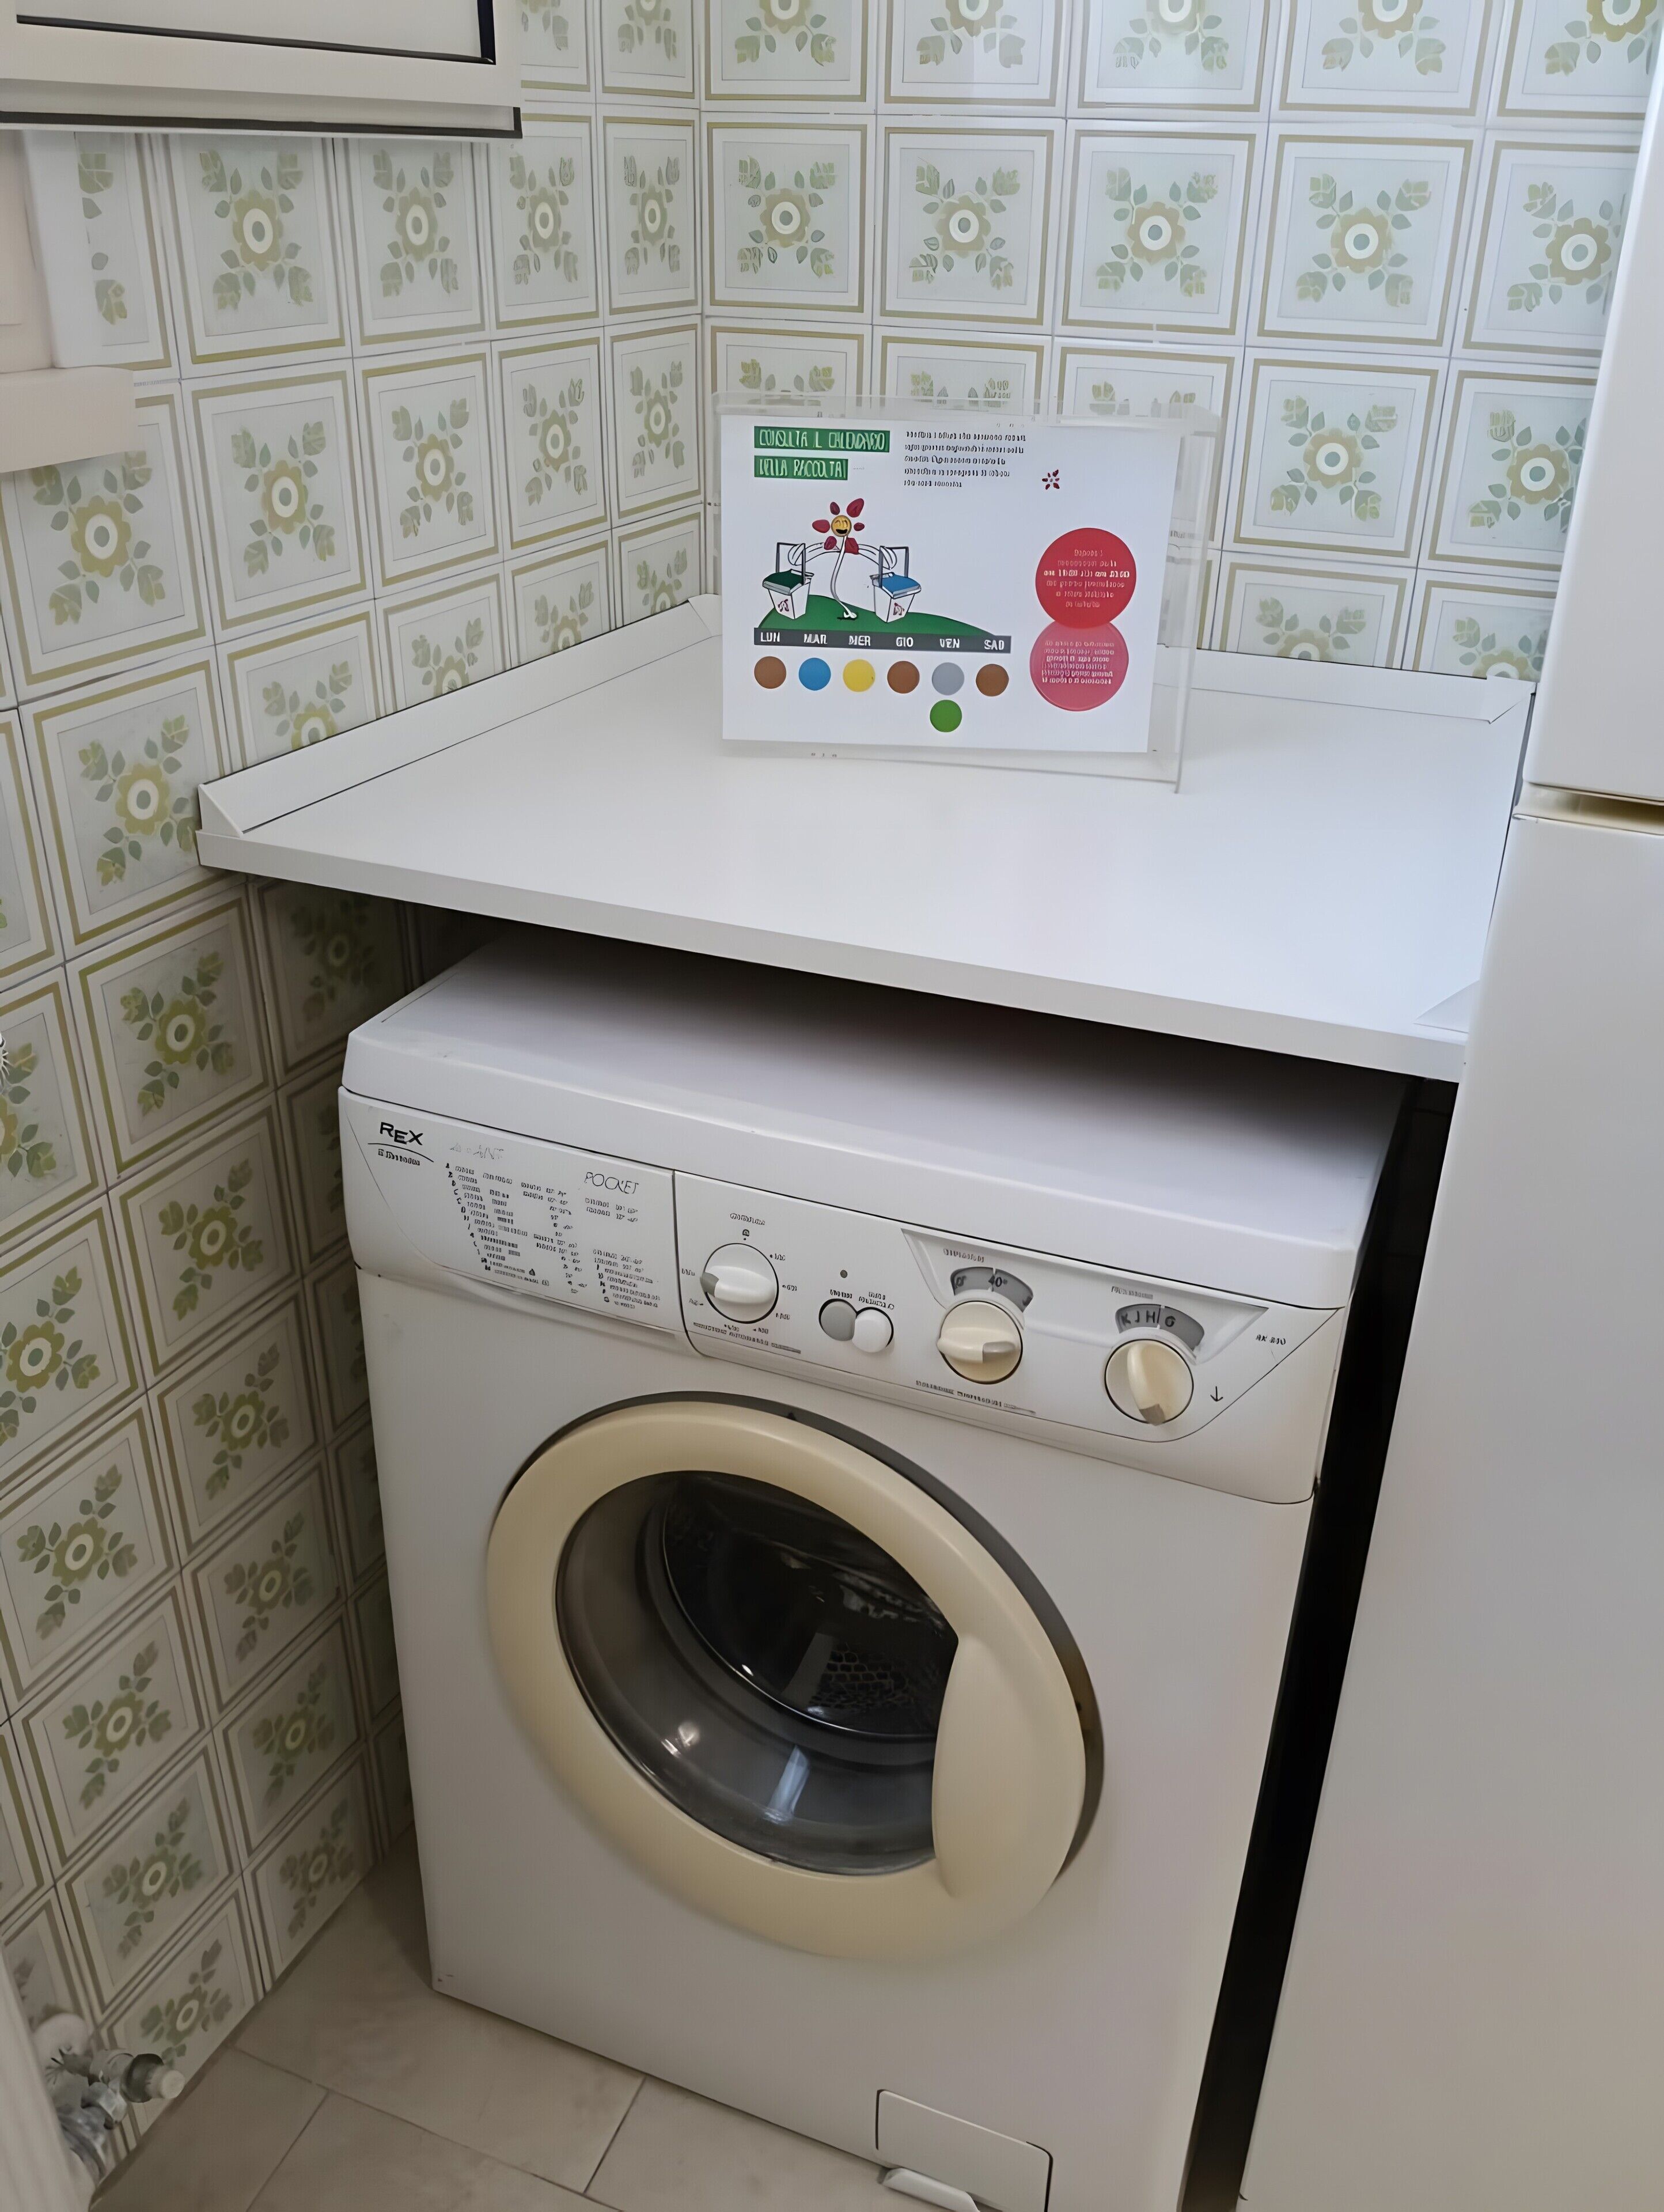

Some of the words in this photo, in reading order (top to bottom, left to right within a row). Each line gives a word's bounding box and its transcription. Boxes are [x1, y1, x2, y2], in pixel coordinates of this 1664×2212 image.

[760, 631, 780, 642] LUN
[896, 637, 914, 647] GIO
[380, 1122, 424, 1146] REX
